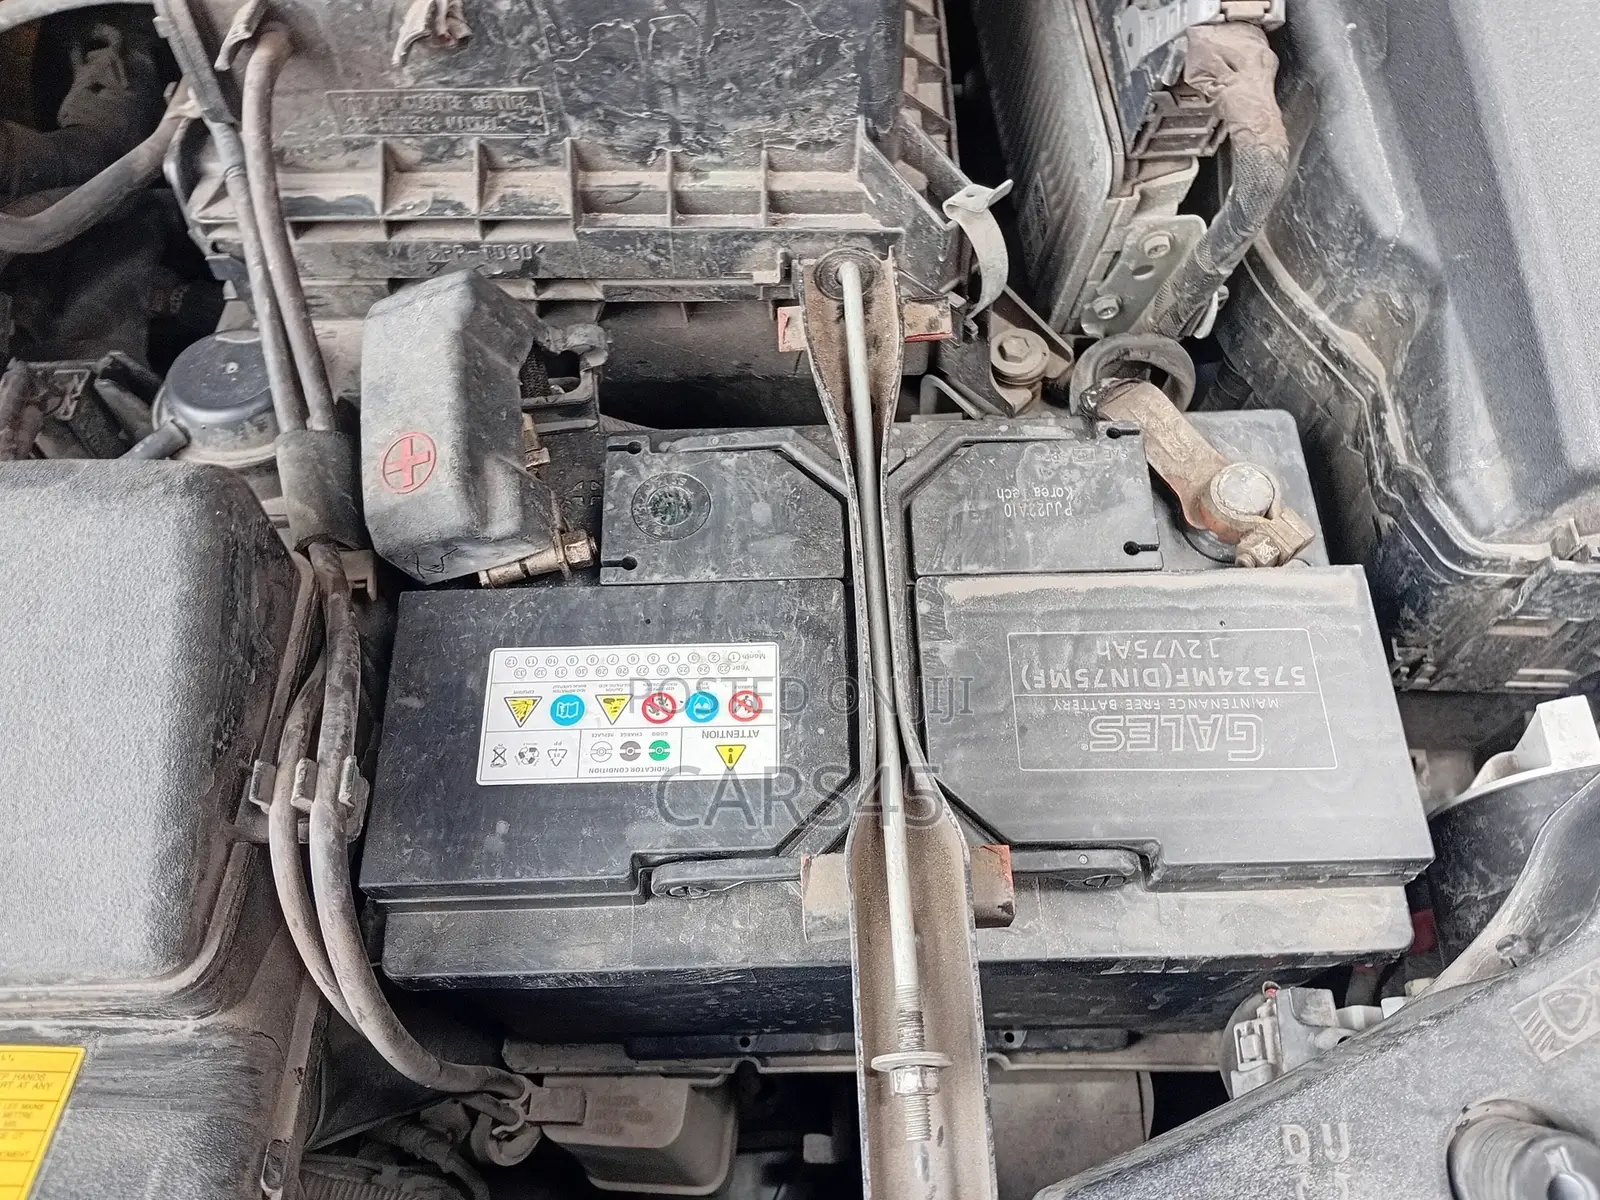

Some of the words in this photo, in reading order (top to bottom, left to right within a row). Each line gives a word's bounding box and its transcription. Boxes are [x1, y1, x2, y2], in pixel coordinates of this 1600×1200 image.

[1033, 486, 1074, 502] Korea
[742, 651, 766, 661] Month
[1096, 638, 1220, 661] 12V75Ah
[1021, 663, 1306, 691] 57524MF(DIN75MF)
[1052, 699, 1119, 712] BATTERY
[1125, 698, 1161, 710] FREE
[1168, 697, 1280, 710] MAINTENANCE
[701, 729, 760, 739] ATTENTION
[1088, 714, 1265, 762] GALES
[588, 766, 629, 774] CONDITION
